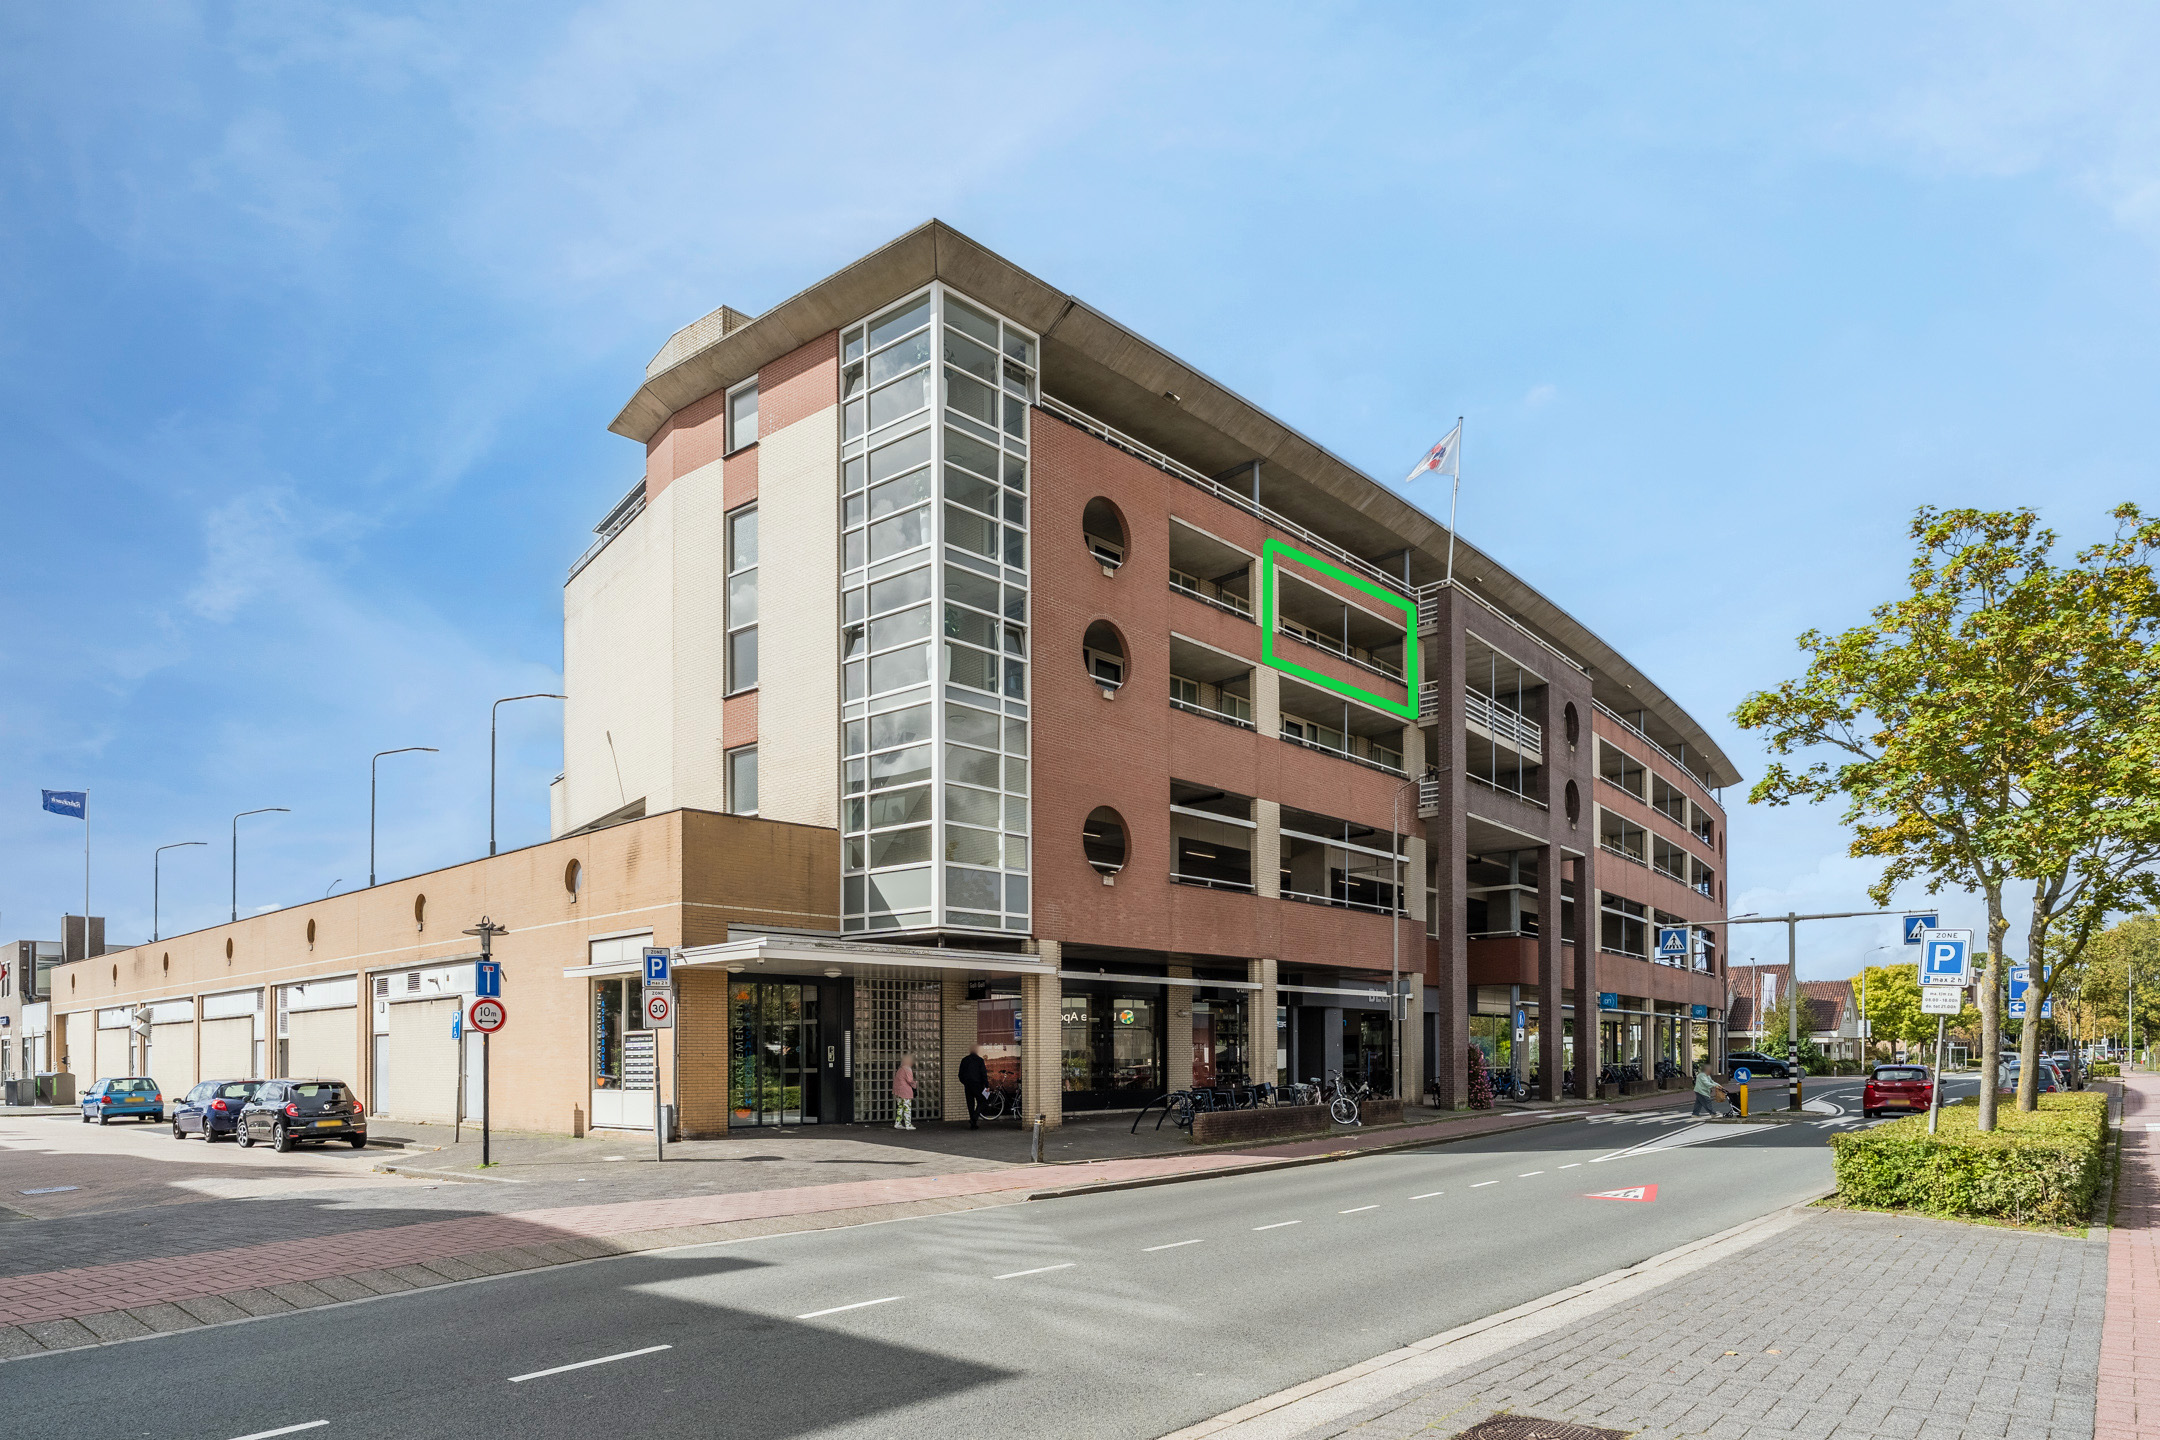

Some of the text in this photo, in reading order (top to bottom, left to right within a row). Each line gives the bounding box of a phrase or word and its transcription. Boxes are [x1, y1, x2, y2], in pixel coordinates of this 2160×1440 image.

[1934, 945, 1956, 970] P
[651, 958, 663, 977] P
[652, 1004, 665, 1013] 30
[453, 1013, 459, 1027] P
[735, 1002, 744, 1106] APPARTEMENTEN
